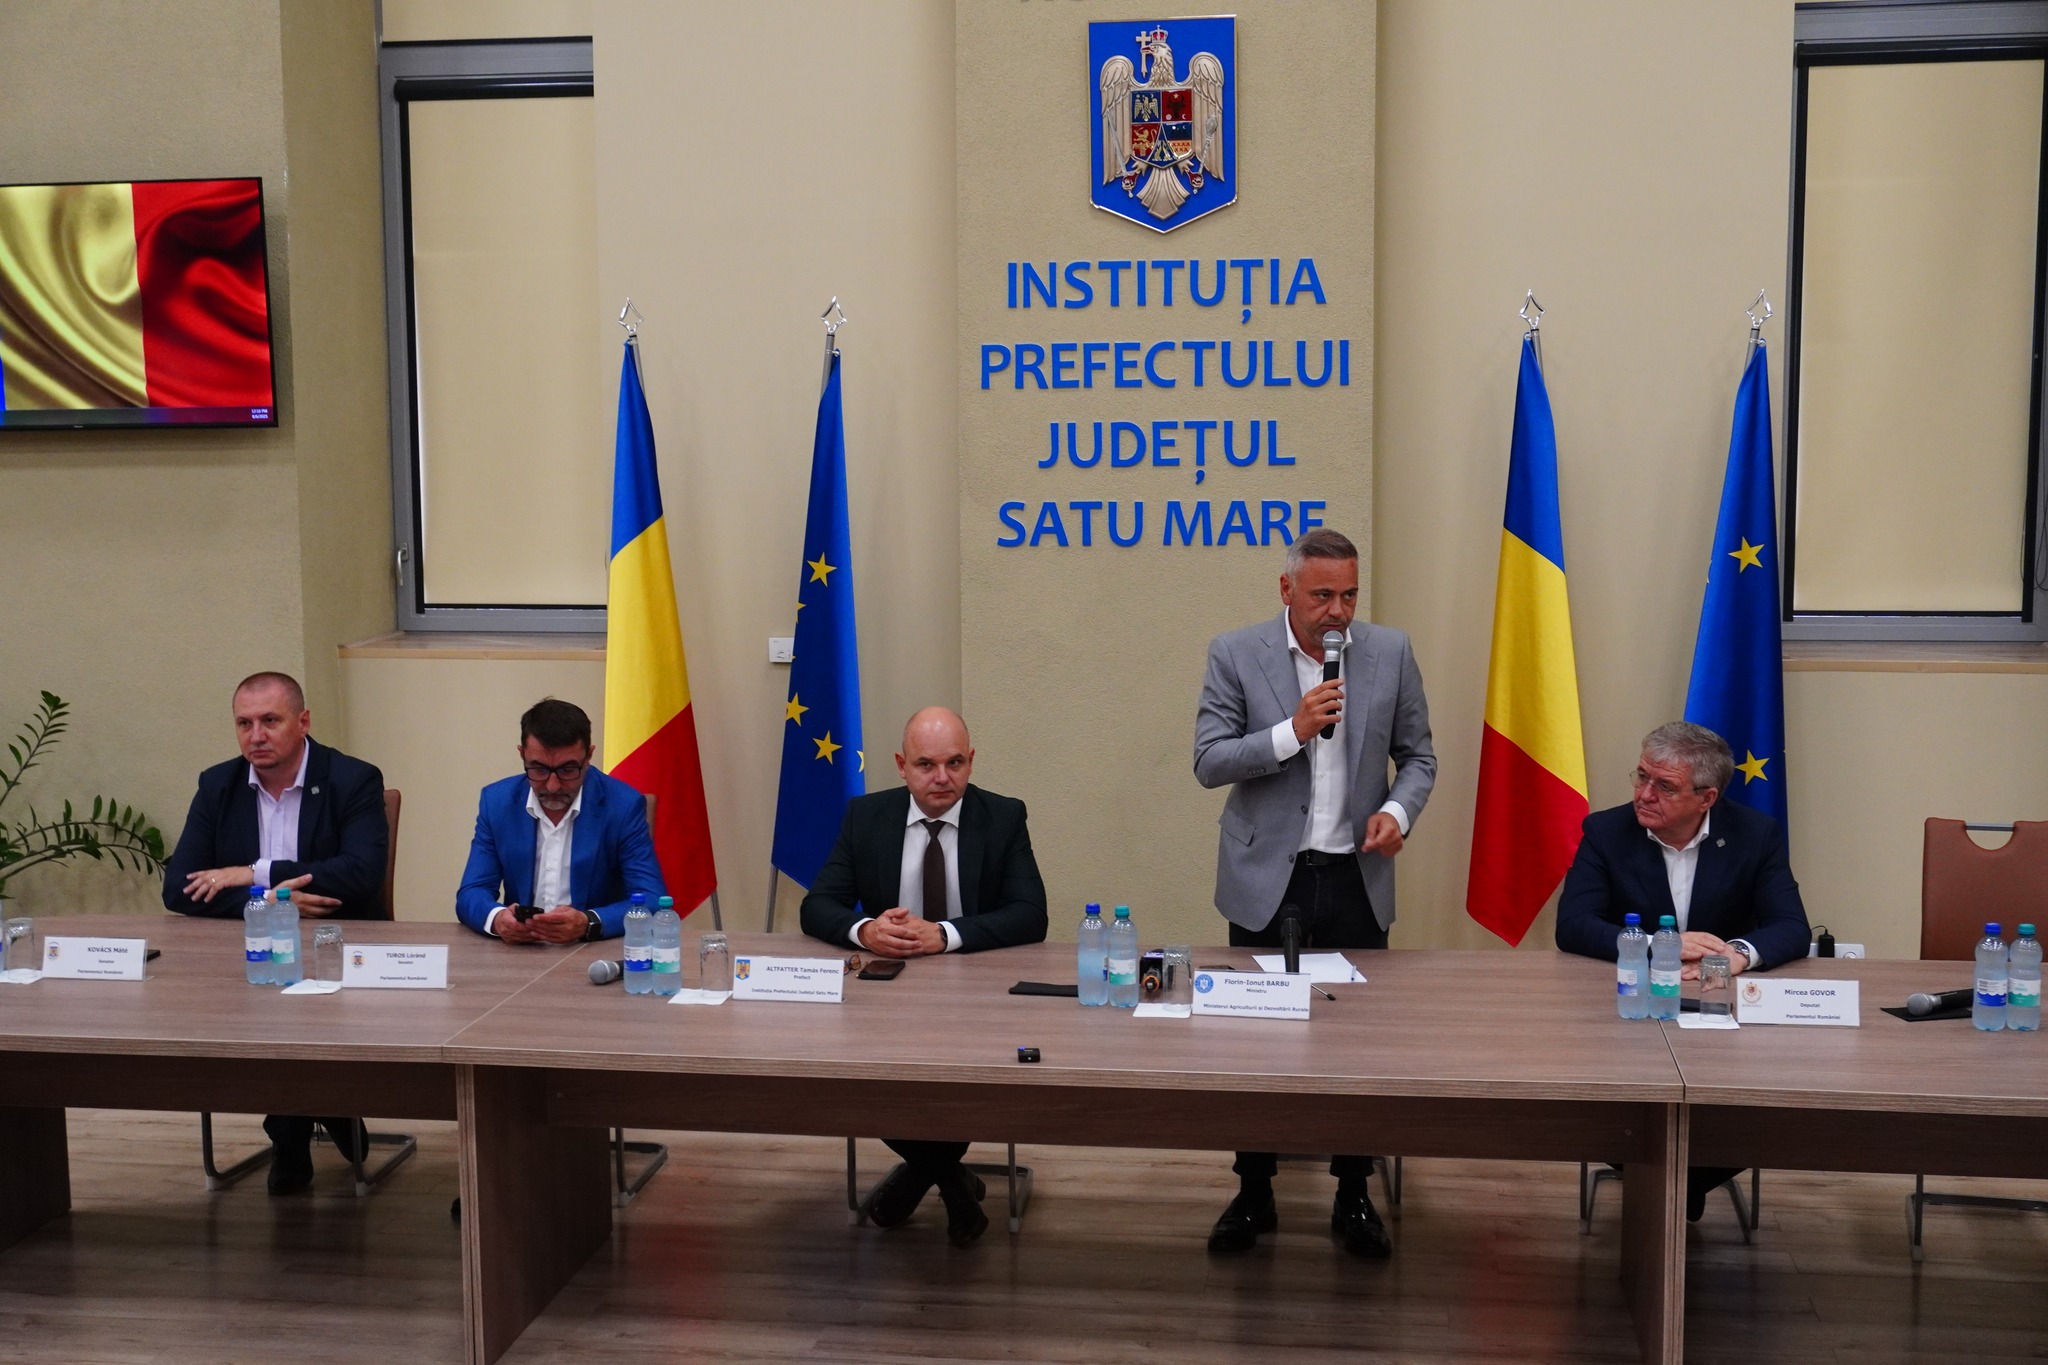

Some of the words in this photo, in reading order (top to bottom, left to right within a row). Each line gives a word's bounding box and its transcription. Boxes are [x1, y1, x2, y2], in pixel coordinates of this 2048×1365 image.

[1007, 257, 1327, 324] INSTITUȚIA
[980, 339, 1350, 390] PREFECTULUI
[1038, 420, 1296, 485] JUDEȚUL
[997, 501, 1144, 547] SATU
